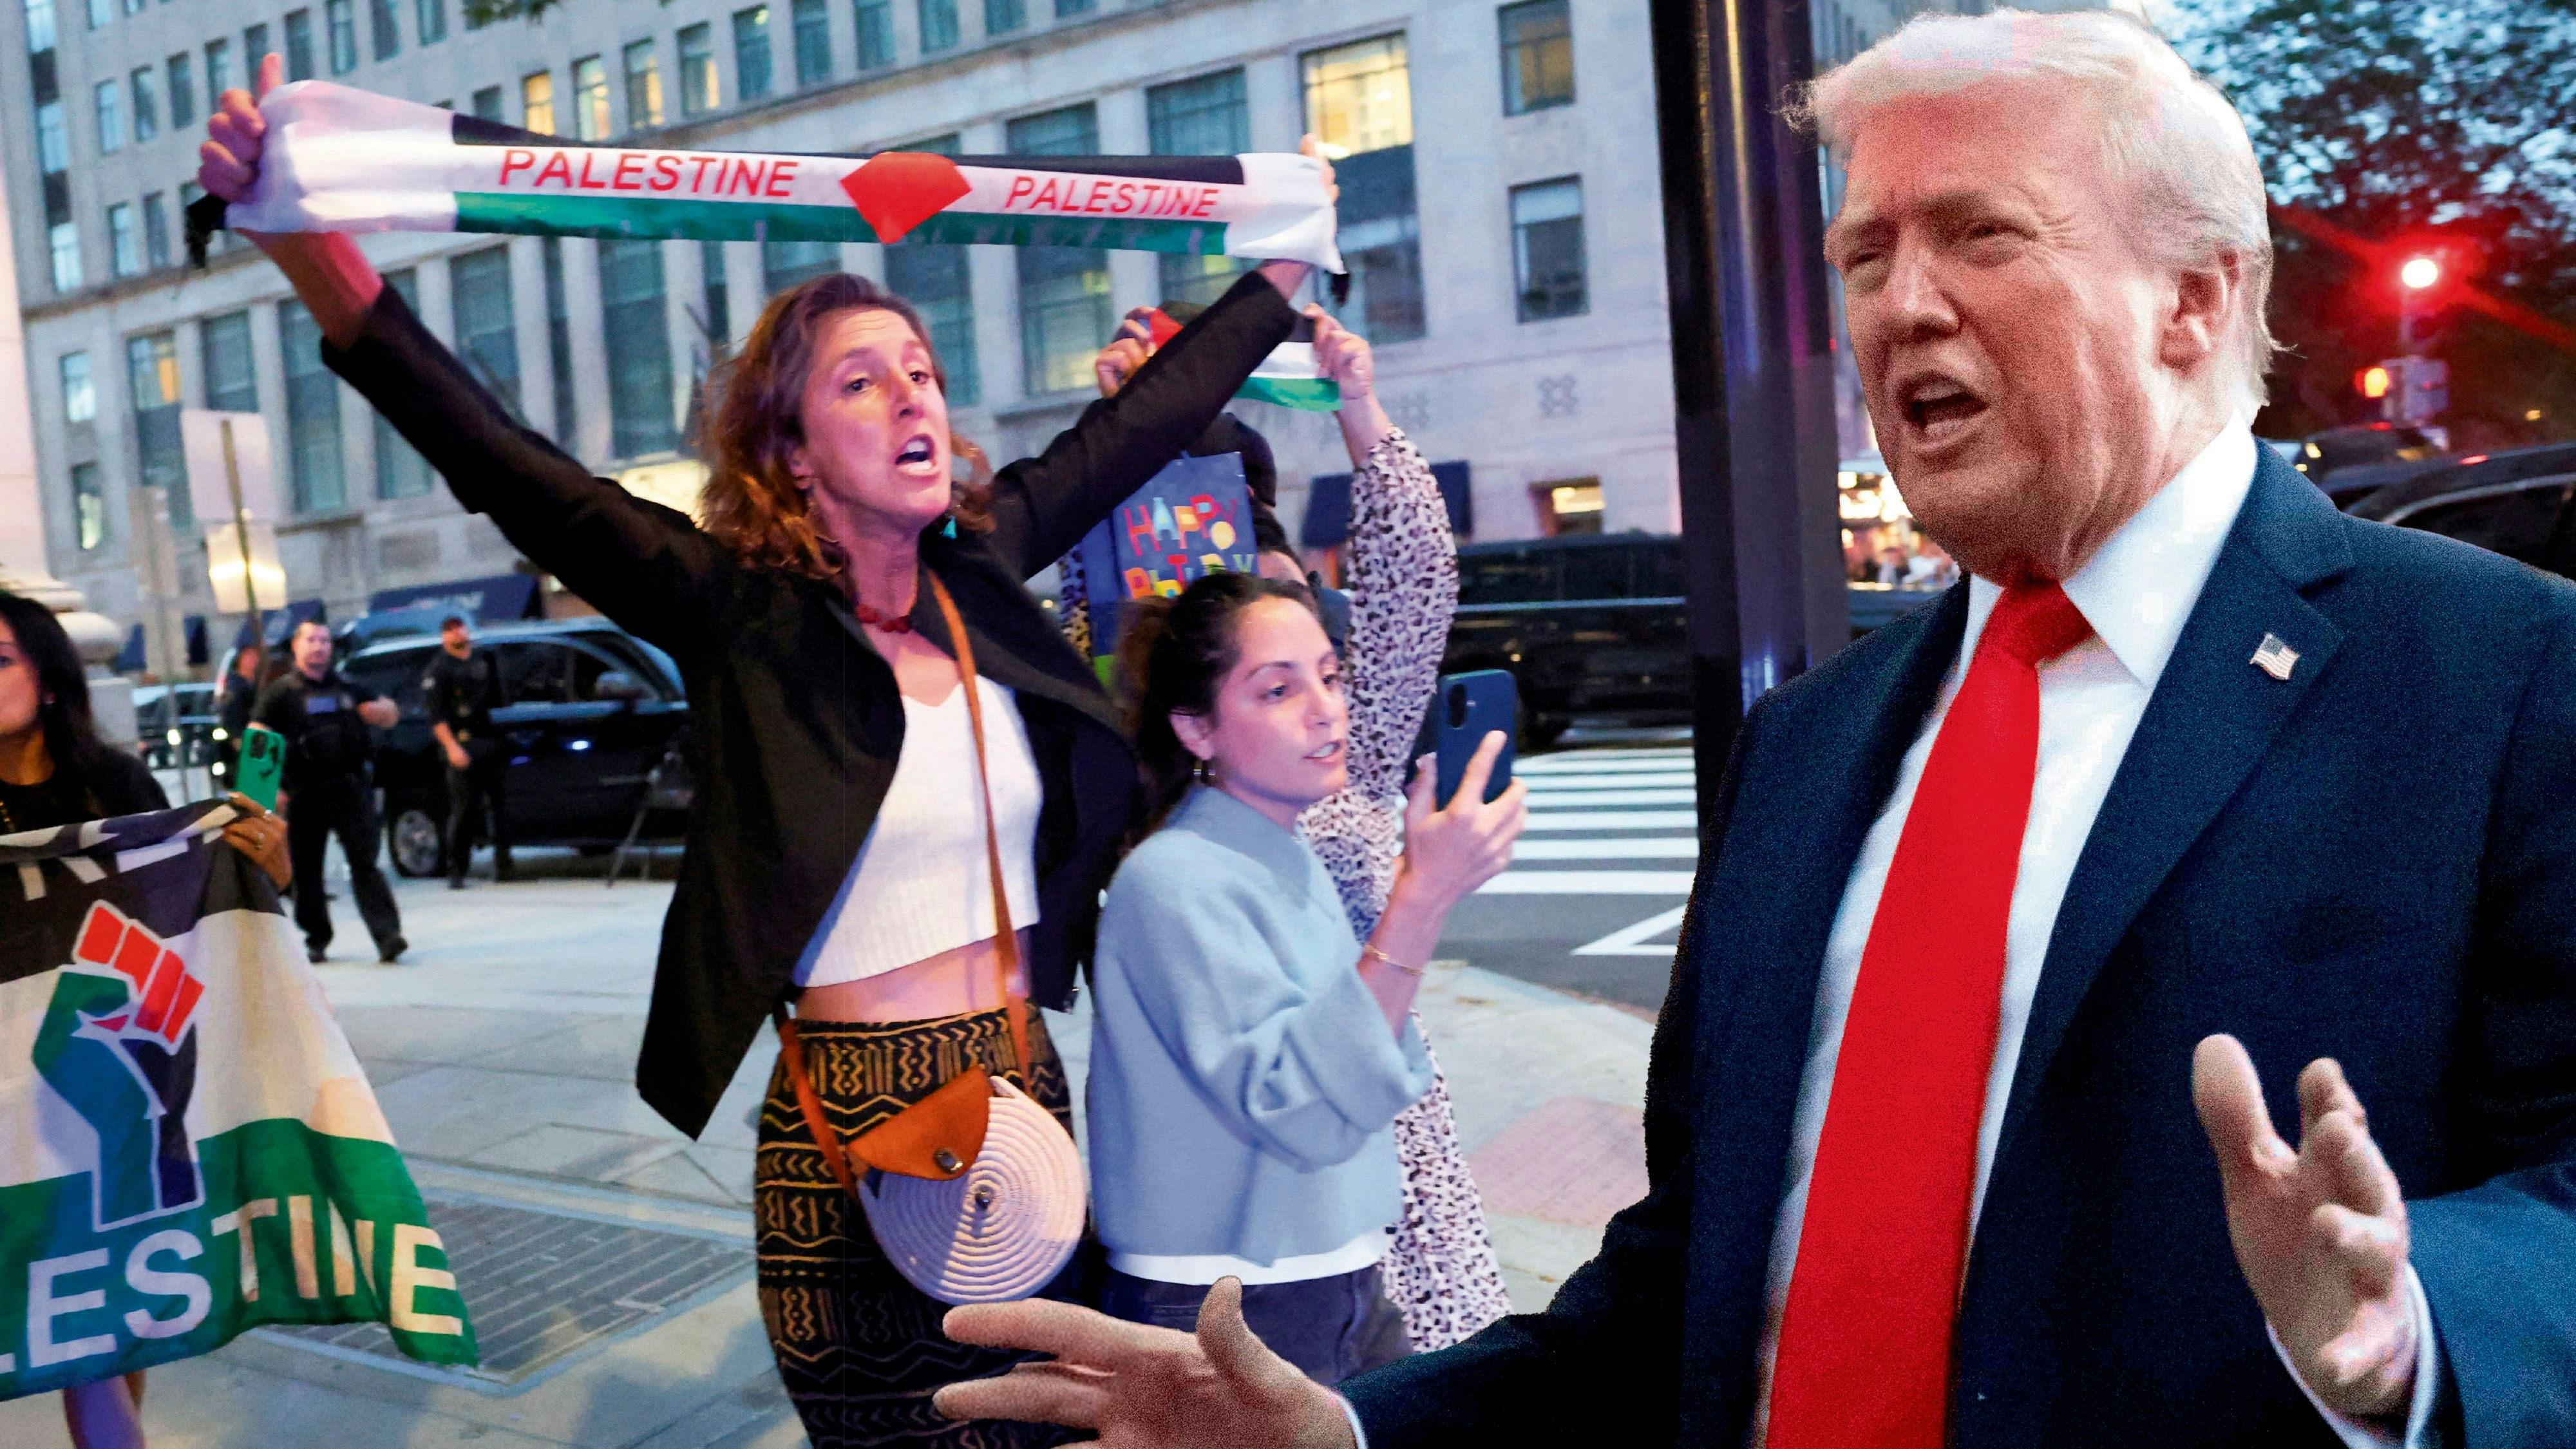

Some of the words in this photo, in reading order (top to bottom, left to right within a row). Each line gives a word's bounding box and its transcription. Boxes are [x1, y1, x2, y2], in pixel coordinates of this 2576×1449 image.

[499, 149, 798, 196] PALESTINE
[1005, 176, 1219, 217] PALESTINE
[1124, 494, 1237, 556] HAPPY
[0, 1195, 463, 1374] ESTINE
